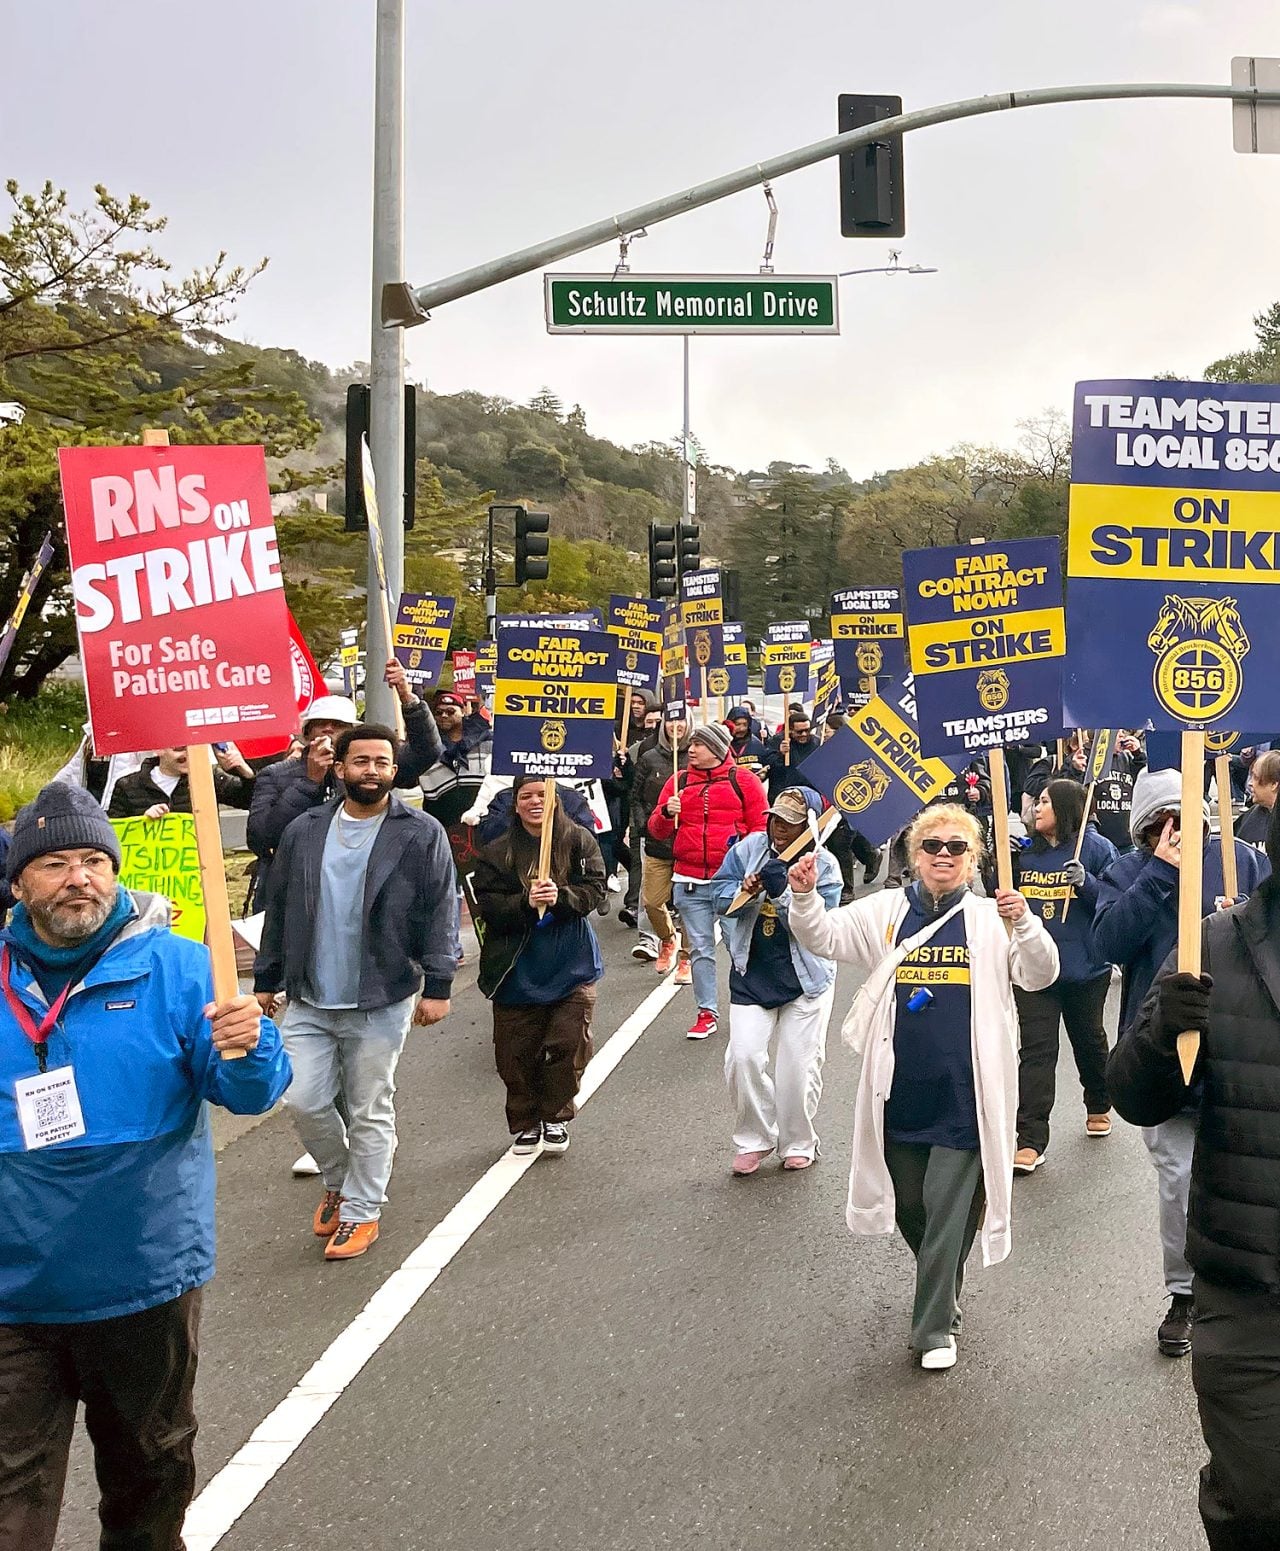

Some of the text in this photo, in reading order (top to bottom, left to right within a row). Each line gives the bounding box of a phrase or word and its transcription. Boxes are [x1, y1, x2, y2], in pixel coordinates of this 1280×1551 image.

[568, 290, 819, 317] Schultz Memorial Drive
[1116, 433, 1220, 470] LOCAL
[90, 465, 251, 542] RNs ON
[1173, 497, 1230, 524] ON
[956, 553, 1008, 575] FAIR
[72, 525, 285, 633] STRIKE
[682, 573, 719, 587] TEAMSTERS
[918, 567, 1047, 598] CONTRACT
[834, 590, 899, 602] TEAMSTERS
[953, 589, 1018, 613] NOW!
[417, 600, 438, 610] FAIR
[628, 602, 648, 613] FAIR
[842, 601, 890, 610] LOCAL 856
[403, 606, 450, 619] CONTRACT
[614, 608, 660, 622] CONTRACT
[685, 609, 720, 624] STRIKE
[412, 615, 436, 625] NOW!
[625, 617, 648, 628] NOW!
[859, 616, 875, 624] ON
[415, 627, 427, 636] ON
[629, 630, 641, 639] ON
[768, 625, 809, 633] TEAMSTERS
[838, 624, 897, 636] STRIKE
[971, 619, 1004, 637] ON
[397, 634, 443, 648] STRIKE
[538, 637, 580, 650] FAIR
[619, 637, 657, 651] TRIKE
[924, 629, 1052, 667] STRIKE
[109, 634, 217, 667] For Safe
[508, 649, 609, 665] CONTRACT
[769, 652, 806, 662] STRIKE
[453, 668, 476, 682] STRIK
[532, 662, 584, 677] NOW!
[113, 661, 272, 698] Patient Care
[1174, 669, 1222, 690] 856
[543, 684, 569, 696] ON
[505, 695, 605, 714] STRIKE
[943, 708, 1049, 737] TEAMSTERS
[900, 731, 921, 755] ON
[964, 728, 1030, 749] LOCAL 856
[511, 752, 593, 766] TEAMSTERS
[859, 716, 936, 794] STRIKE
[525, 765, 577, 776] LOCAL 856
[844, 785, 865, 804] 856
[1097, 800, 1120, 810] LOCAL
[121, 844, 199, 872] TSIDE
[1019, 870, 1068, 885] TEAMSTE
[1030, 889, 1052, 897] LOCAL
[905, 945, 971, 964] MSTERS
[927, 970, 949, 981] 856
[47, 1079, 72, 1090] STRIKE
[50, 1122, 77, 1134] PATIENT
